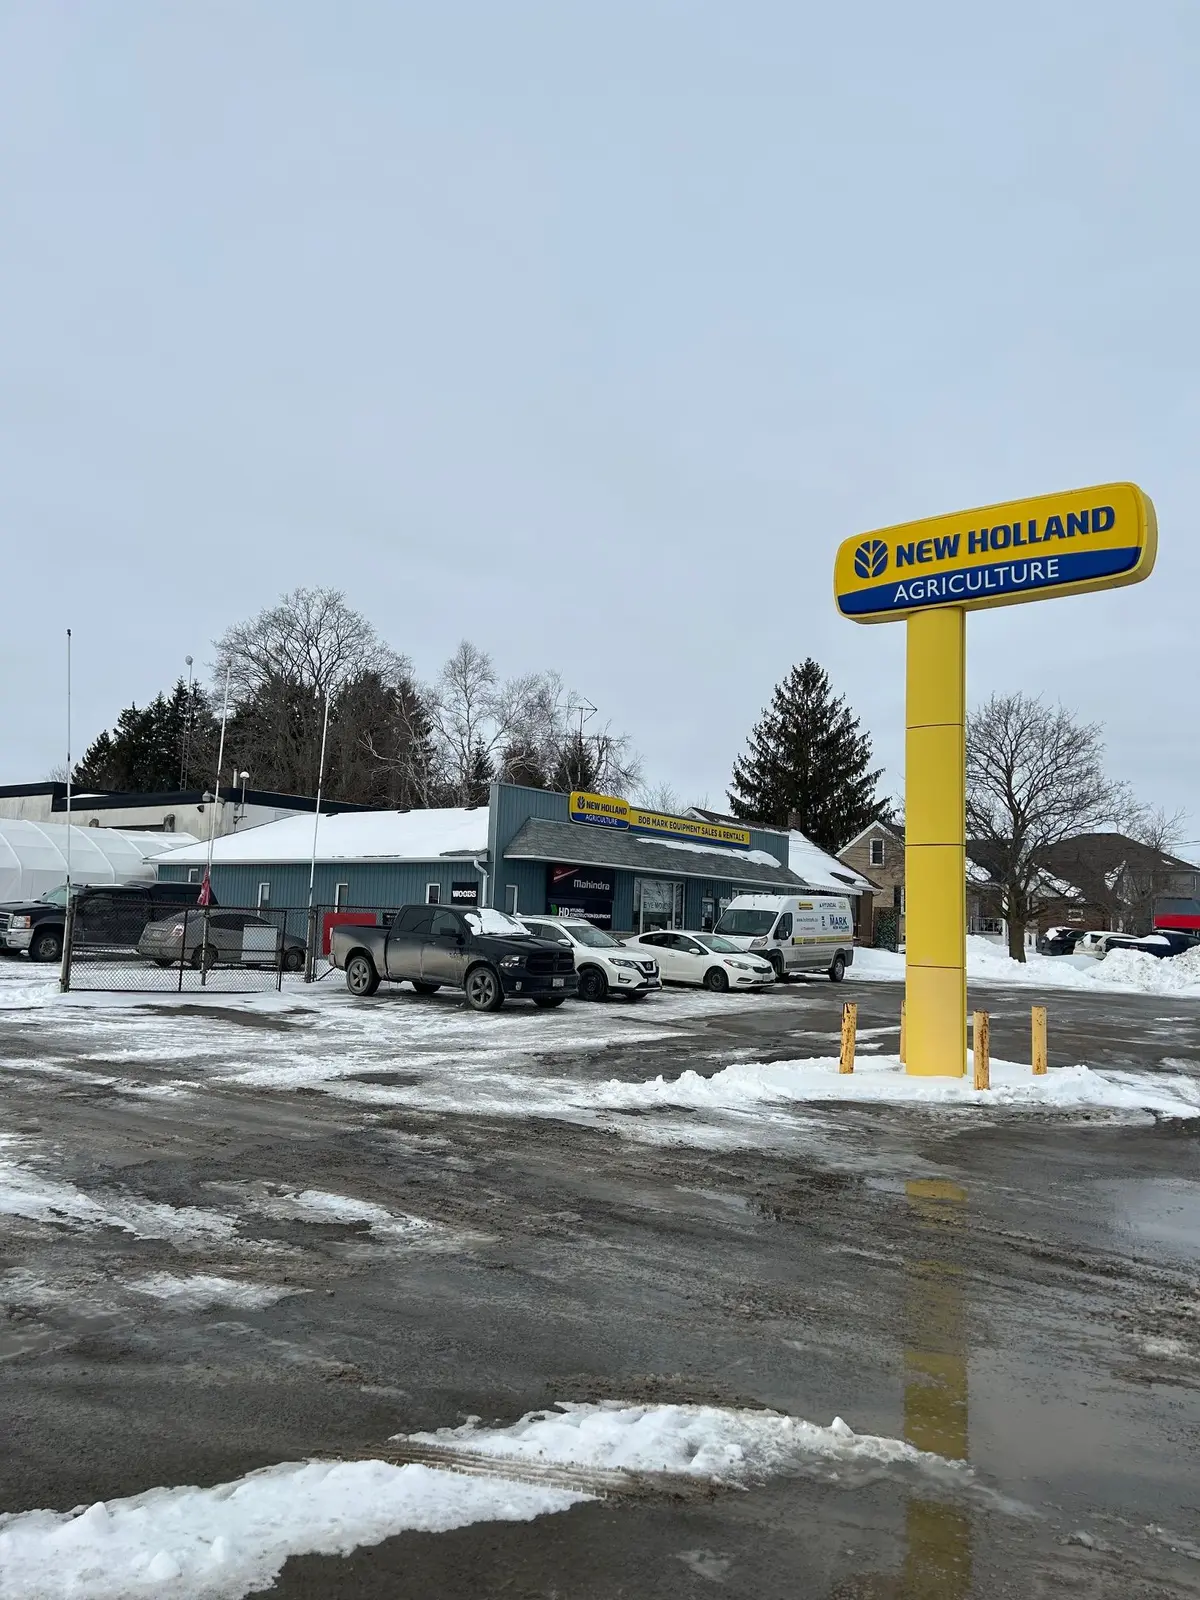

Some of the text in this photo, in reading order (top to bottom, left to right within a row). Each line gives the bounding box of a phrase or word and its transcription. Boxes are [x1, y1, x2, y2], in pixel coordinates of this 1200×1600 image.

[896, 505, 1116, 568] NEW HOLLAND
[893, 559, 1060, 603] AGRICULTURE
[586, 800, 628, 815] NEW HOLLAND
[585, 814, 618, 826] AGRICULTURE
[638, 815, 651, 825] BOB
[651, 818, 669, 828] MARK
[669, 821, 701, 834] EQUIPMENT
[701, 826, 718, 838] SALES
[722, 830, 745, 842] RENTALS
[574, 880, 610, 890] Mahindra
[558, 906, 570, 917] HD
[830, 916, 848, 926] MARK
